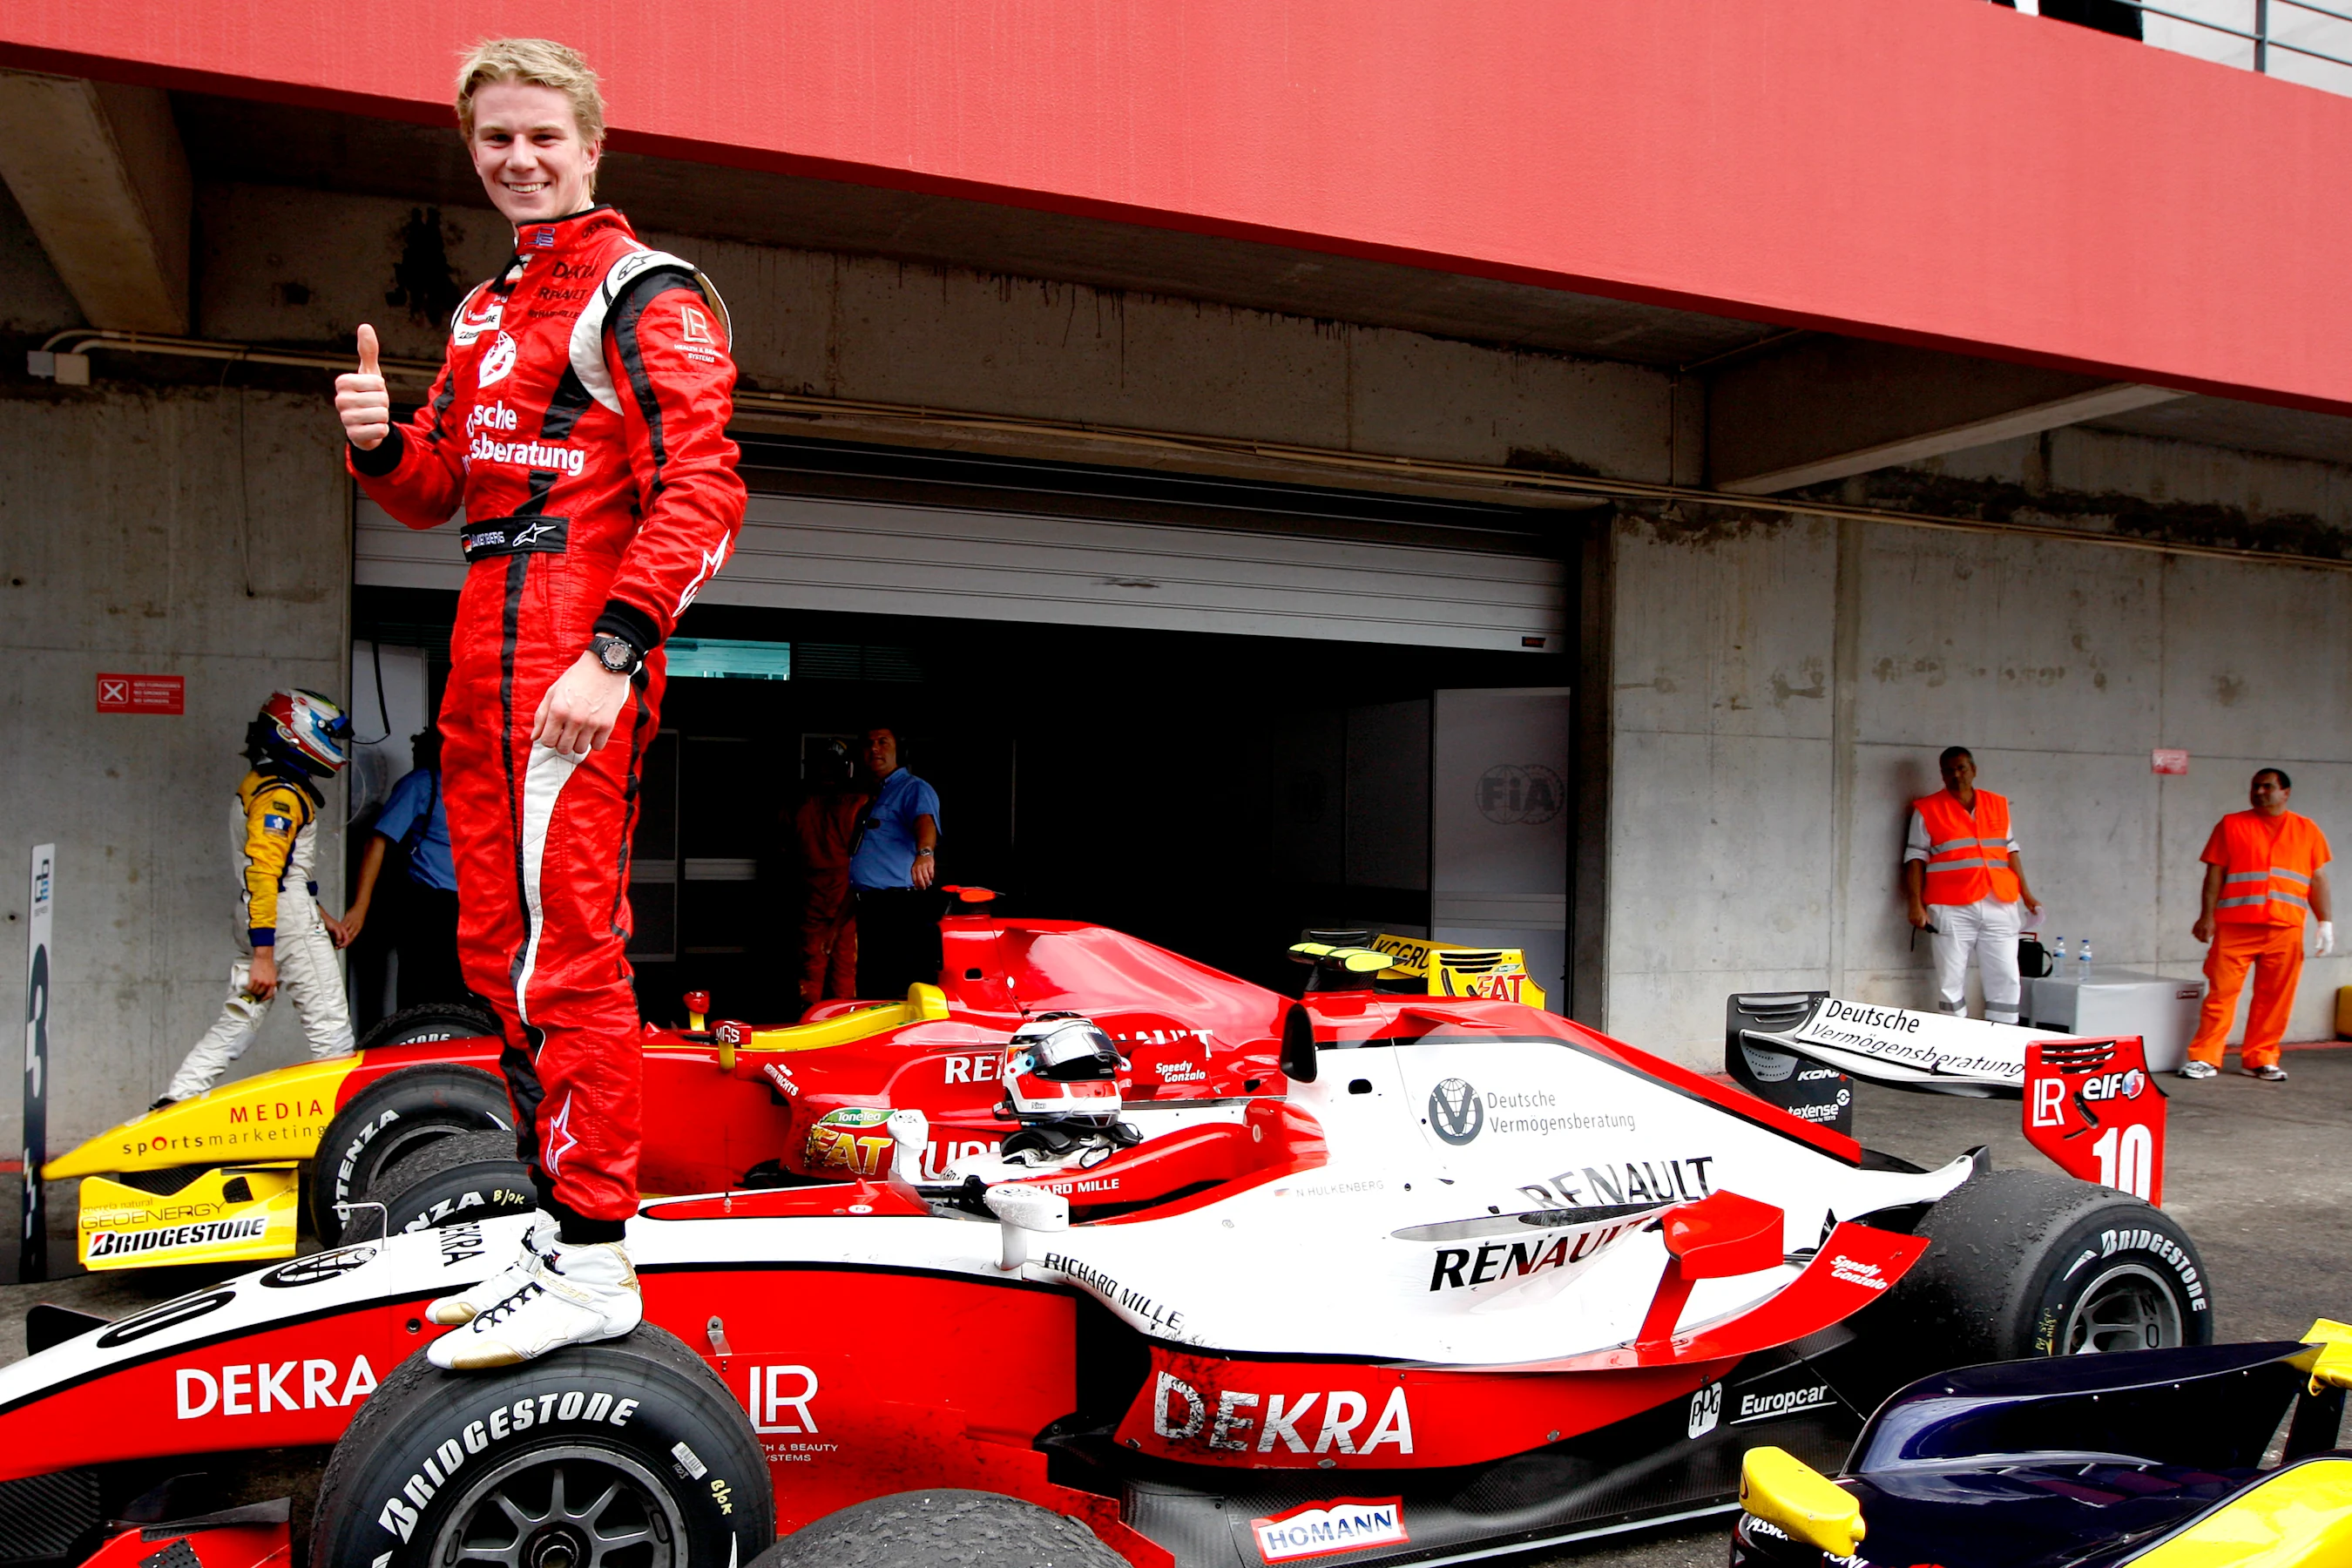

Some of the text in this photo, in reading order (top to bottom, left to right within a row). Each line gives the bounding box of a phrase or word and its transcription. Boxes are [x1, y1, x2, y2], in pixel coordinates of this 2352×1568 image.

[1826, 999, 1920, 1034] Deutsche
[1810, 1023, 2026, 1078] Vermögensberatung
[1155, 1060, 1193, 1075] Speedy
[1164, 1070, 1206, 1083] Gonzalo
[1487, 1090, 1556, 1109] Deutsche
[2083, 1072, 2122, 1100] elf
[229, 1098, 323, 1125] MEDIA
[838, 1111, 882, 1122] ToneTea
[1490, 1112, 1636, 1136] Vermögensberatung
[336, 1109, 401, 1229] OTENZA
[2092, 1124, 2153, 1202] 10
[1078, 1179, 1119, 1193] MILLE
[1308, 1179, 1384, 1196] HULKENBERG
[1514, 1156, 1713, 1209] RENAULT
[81, 1201, 227, 1230] GEOENERGY
[119, 1197, 153, 1208] natural
[398, 1191, 485, 1235] NZA
[89, 1218, 267, 1257] BRIDGESTONE
[1429, 1215, 1652, 1292] RENAULT
[1830, 1254, 1882, 1277] Speedy
[1831, 1267, 1889, 1290] Gonzalo
[2100, 1229, 2207, 1312] BRIDGESTONE
[1045, 1252, 1185, 1331] RICHARD MILLE
[176, 1354, 380, 1420] DEKRA
[749, 1364, 819, 1434] LR
[1740, 1385, 1828, 1416] Europcar
[1153, 1370, 1415, 1455] DEKRA
[790, 1443, 839, 1452] BEAUTY
[377, 1390, 640, 1545] BRIDGESTONE
[1266, 1509, 1394, 1551] HOMANN
